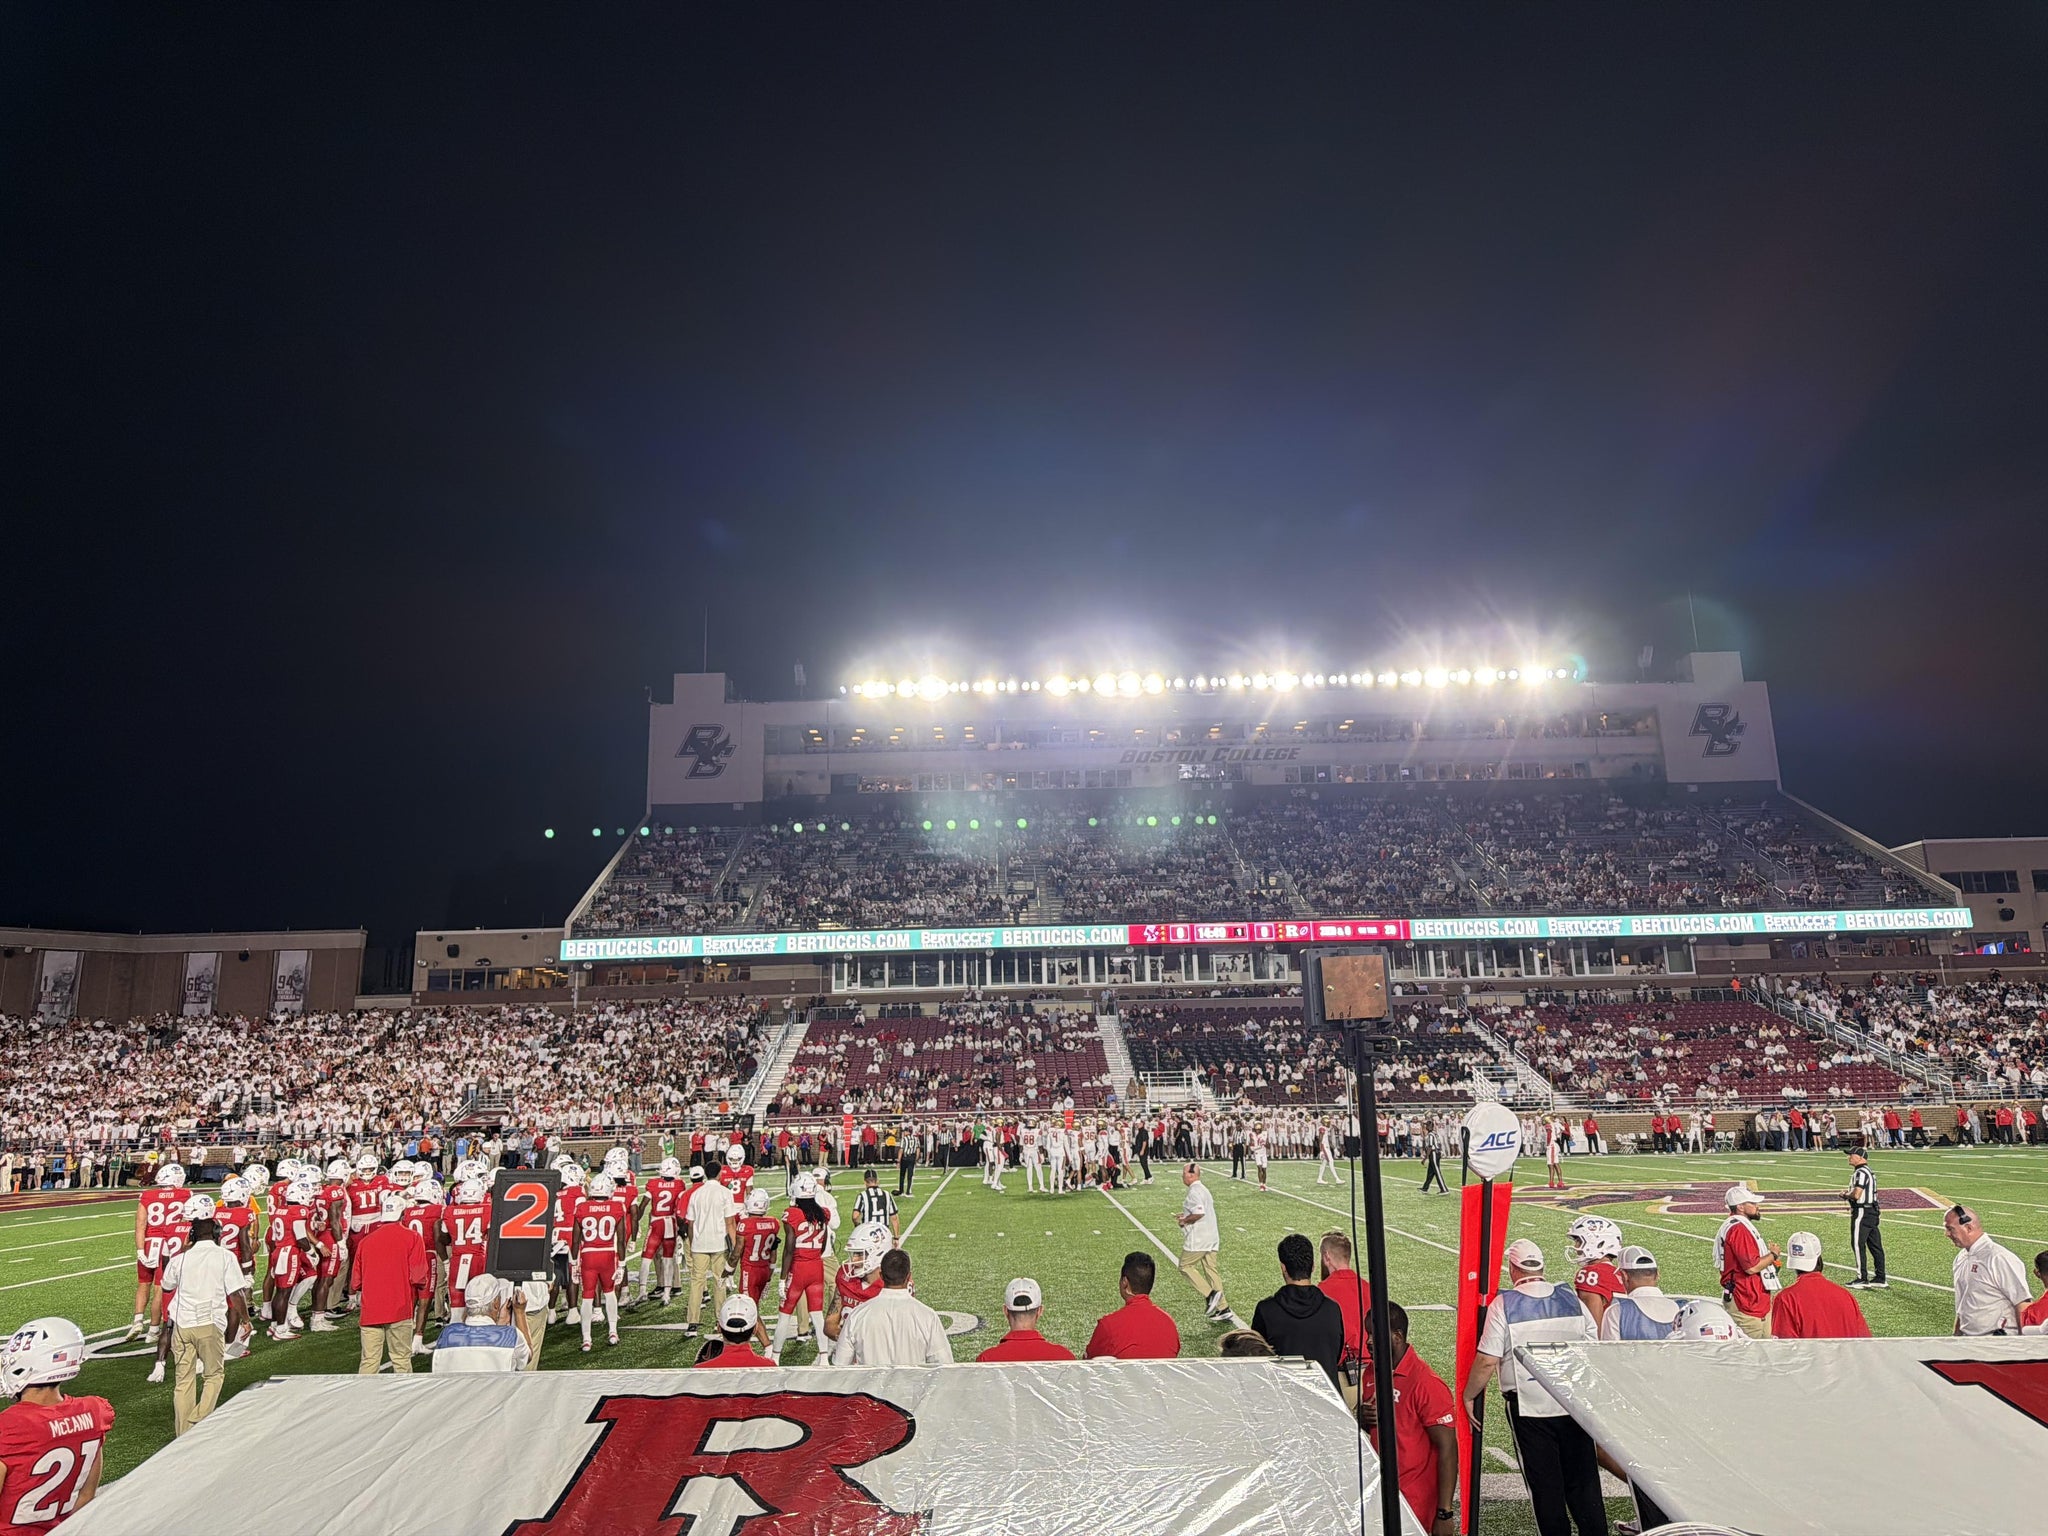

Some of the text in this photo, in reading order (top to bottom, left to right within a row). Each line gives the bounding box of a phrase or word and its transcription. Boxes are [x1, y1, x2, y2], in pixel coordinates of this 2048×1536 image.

[1120, 747, 1300, 763] BOSTON COLLEGE
[1414, 919, 1539, 936] BERTUCCIS.COM
[1631, 915, 1755, 933] BERTUCCIS.COM
[1845, 911, 1969, 929] BERTUCCIS.COM
[565, 939, 693, 957] BERTUCCIS.COM
[786, 932, 910, 950] BERTUCCIS.COM
[1002, 927, 1124, 945] BERTUCCIS.COM
[277, 975, 294, 989] 94
[1479, 1130, 1518, 1148] ACC
[359, 1191, 377, 1209] 11
[499, 1182, 550, 1239] 2
[589, 1205, 605, 1213] THOMAS
[656, 1190, 672, 1211] 2
[872, 1197, 884, 1215] L
[147, 1201, 184, 1227] 82
[454, 1217, 483, 1246] 14
[581, 1215, 616, 1242] 80
[795, 1221, 826, 1249] 22
[869, 1228, 886, 1244] 37
[1586, 1220, 1604, 1233] 37
[750, 1233, 776, 1262] 18
[1576, 1269, 1599, 1286] 58
[9, 1330, 38, 1353] 37
[47, 1373, 67, 1381] NEVER
[50, 1413, 94, 1438] McCANN
[501, 1390, 934, 1536] R
[10, 1438, 101, 1525] 21
